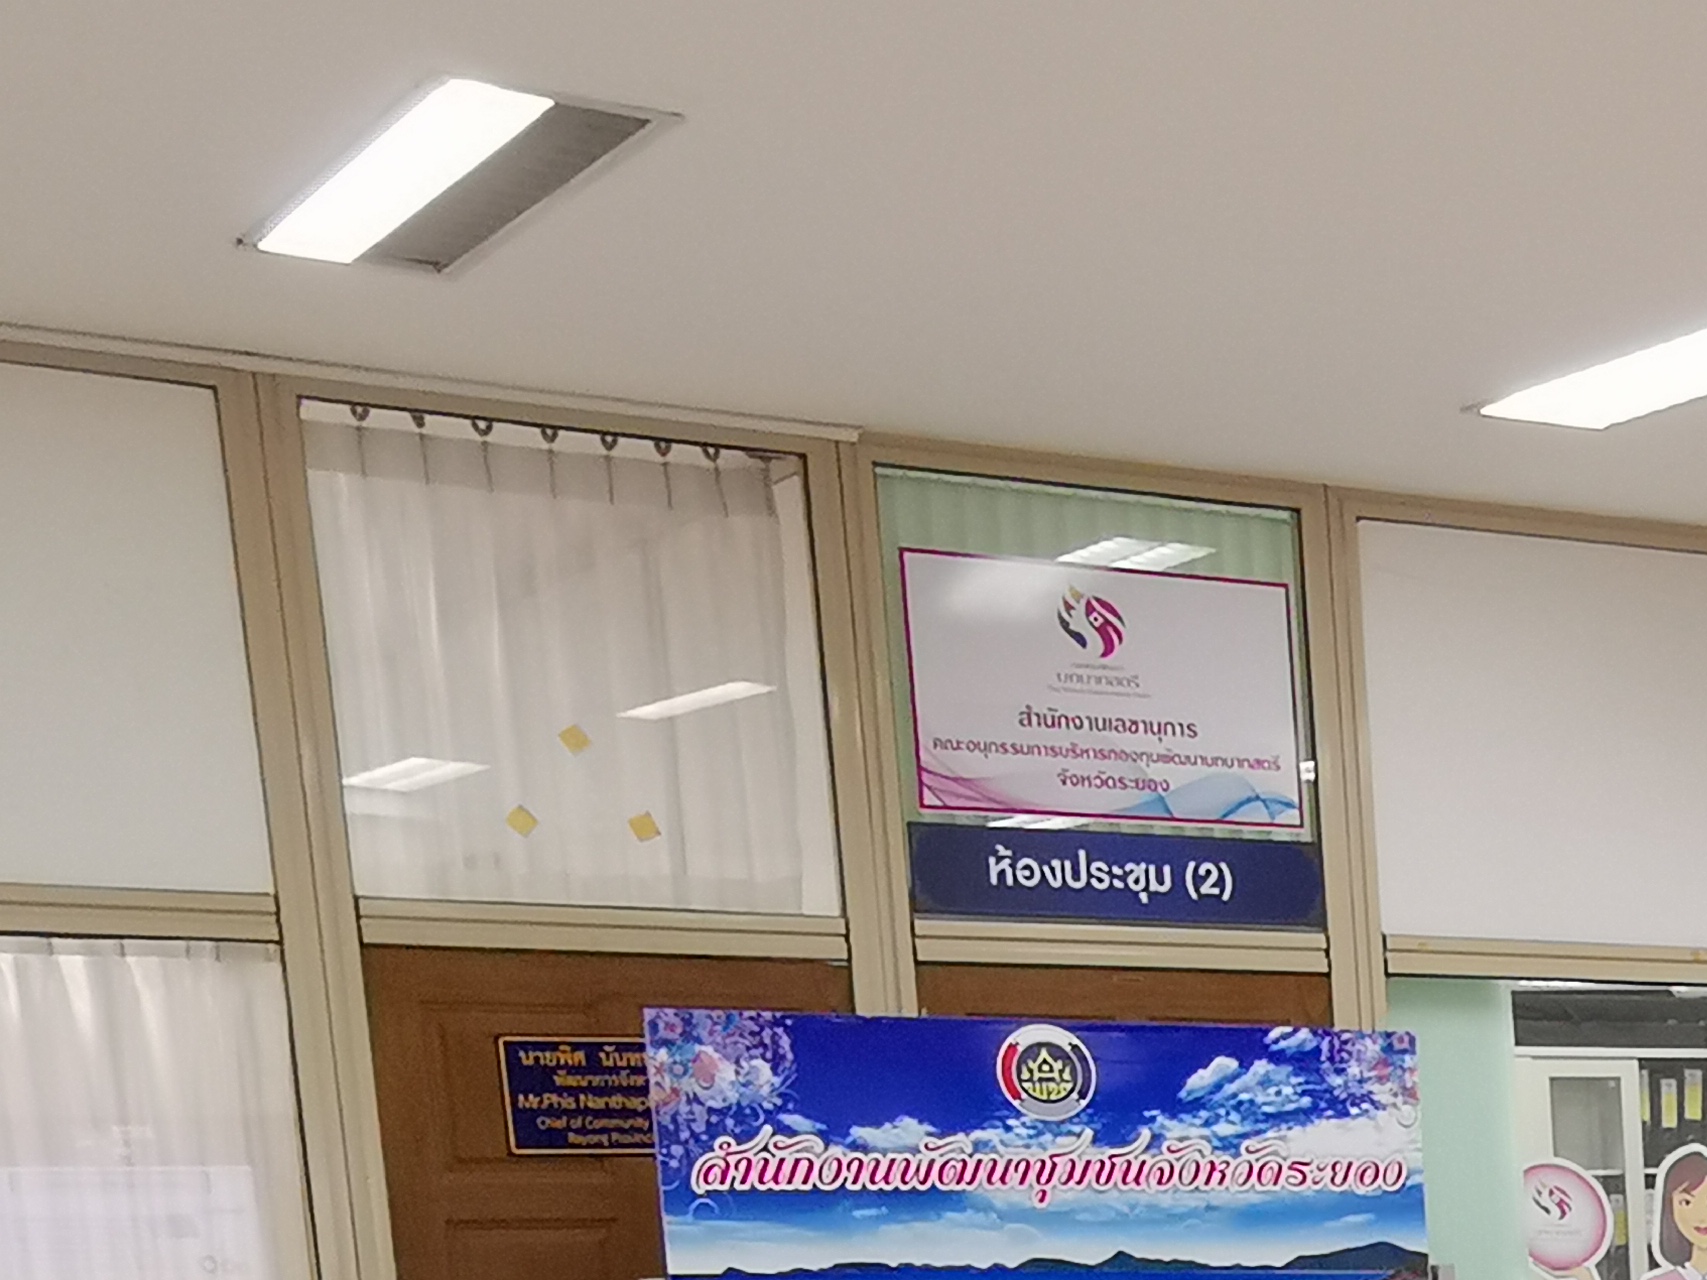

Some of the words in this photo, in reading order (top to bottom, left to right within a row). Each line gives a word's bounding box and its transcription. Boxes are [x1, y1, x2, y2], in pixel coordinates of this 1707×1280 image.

[1017, 703, 1199, 744] สำนักงานเลขานุการ
[1056, 767, 1171, 793] จังหวัดระยอง
[988, 843, 1173, 904] ห้องประชุม
[1185, 860, 1234, 902] (2)
[694, 1127, 1408, 1206] สำนักงานพัฒนาชุมชนจังหวัดระยอง
